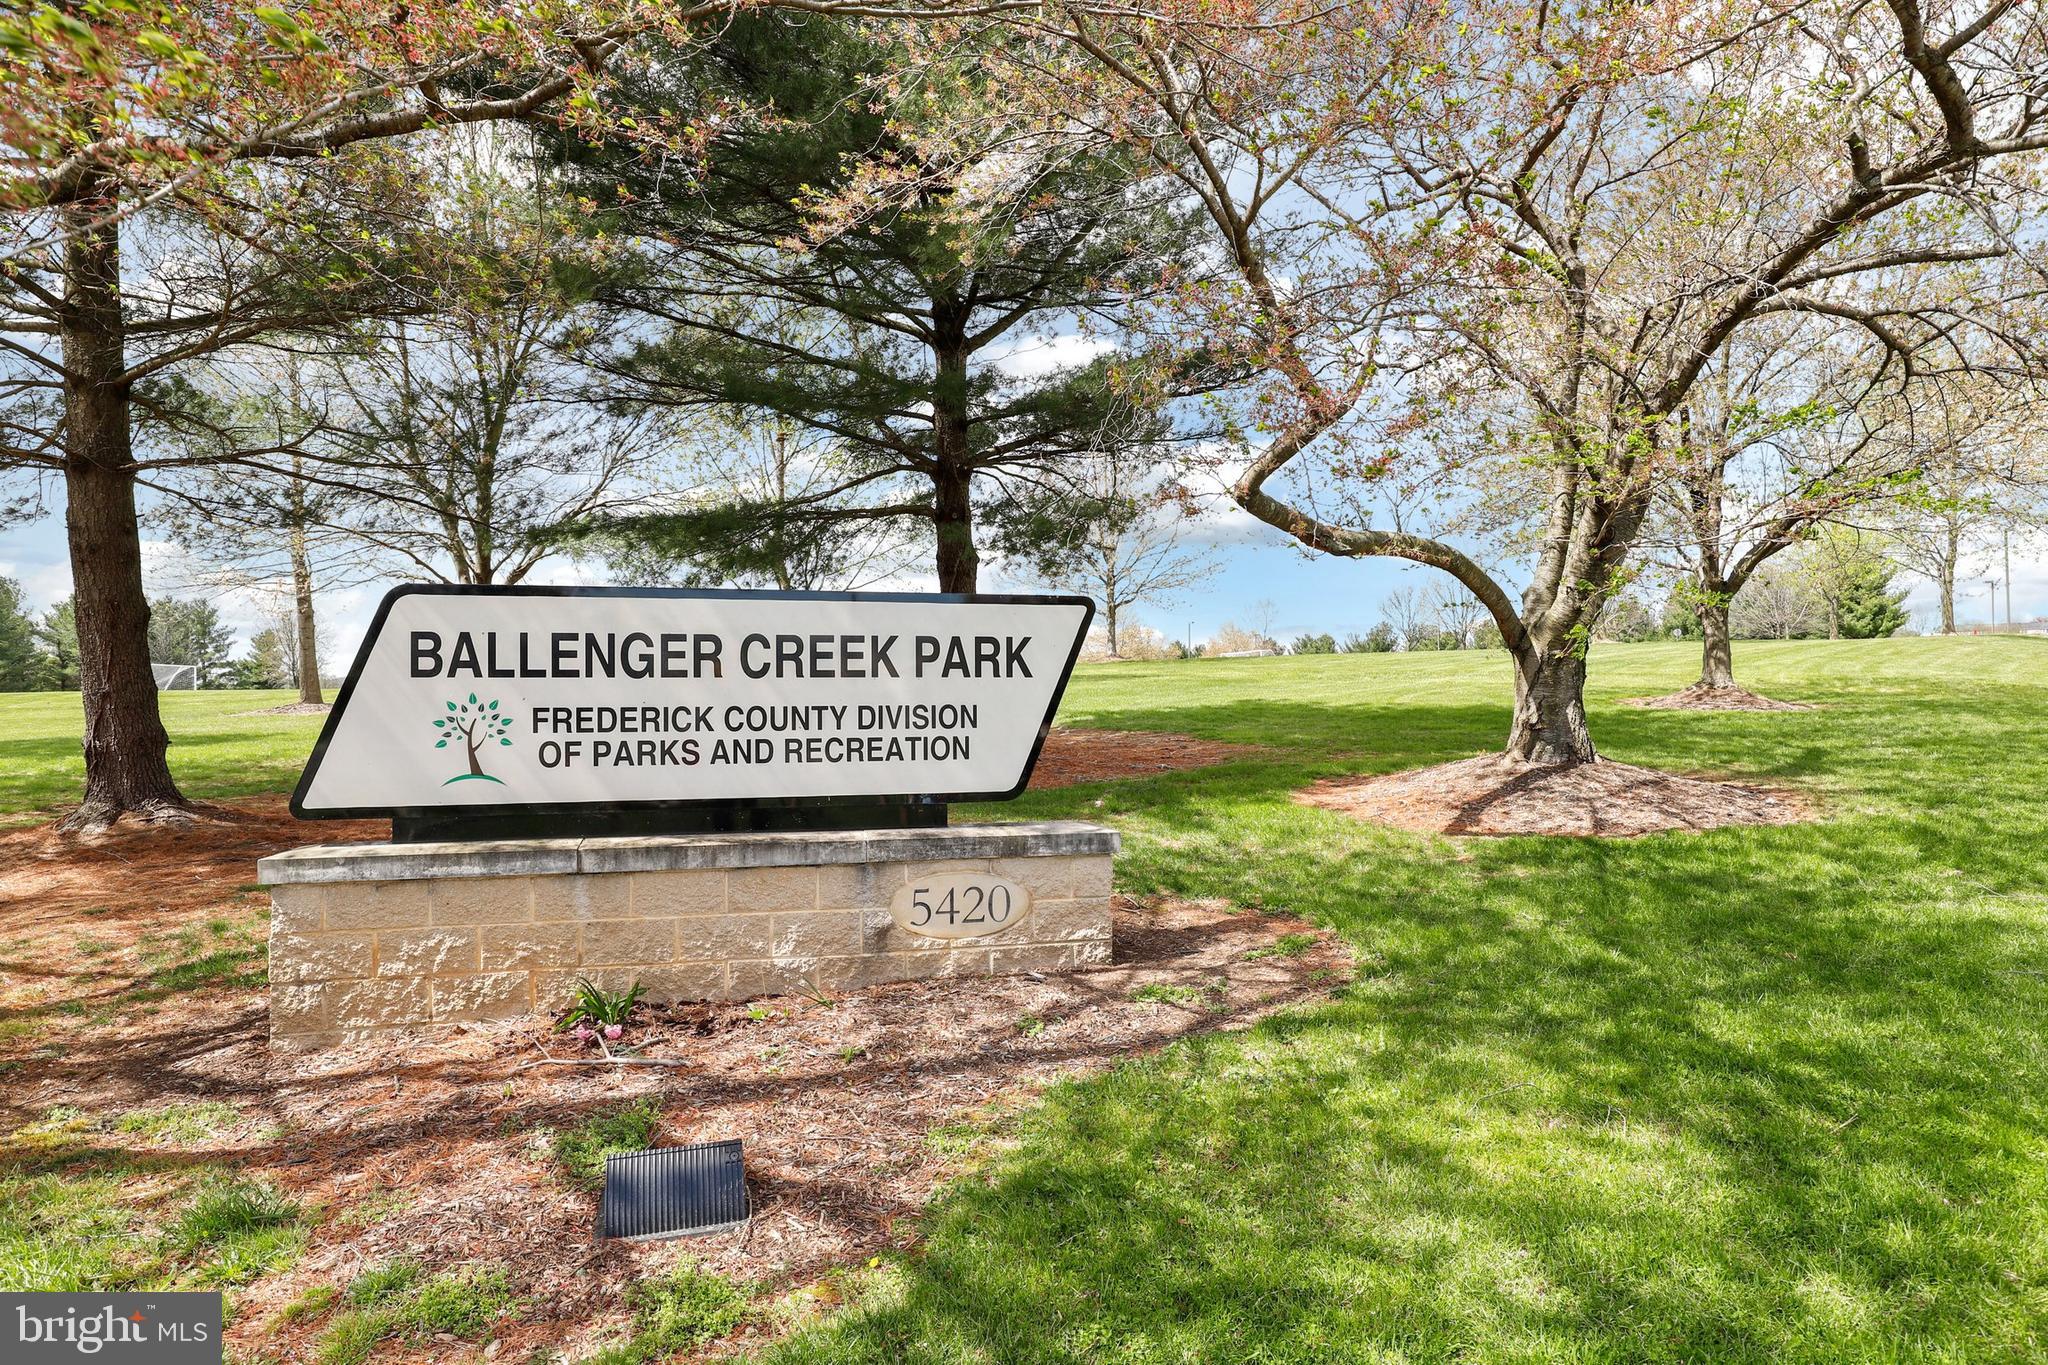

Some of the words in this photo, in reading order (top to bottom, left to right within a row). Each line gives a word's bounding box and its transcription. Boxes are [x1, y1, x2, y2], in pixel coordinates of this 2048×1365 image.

[410, 631, 723, 679] BALLENGER
[740, 633, 900, 679] CREEK
[915, 635, 1034, 678] PARK
[532, 705, 714, 735] FREDERICK
[724, 705, 848, 733] COUNTY
[857, 703, 978, 731] DIVISION
[538, 740, 582, 768] OF
[593, 738, 700, 767] PARKS
[710, 738, 774, 765] AND
[784, 735, 970, 764] RECREATION
[910, 885, 1011, 926] 5420
